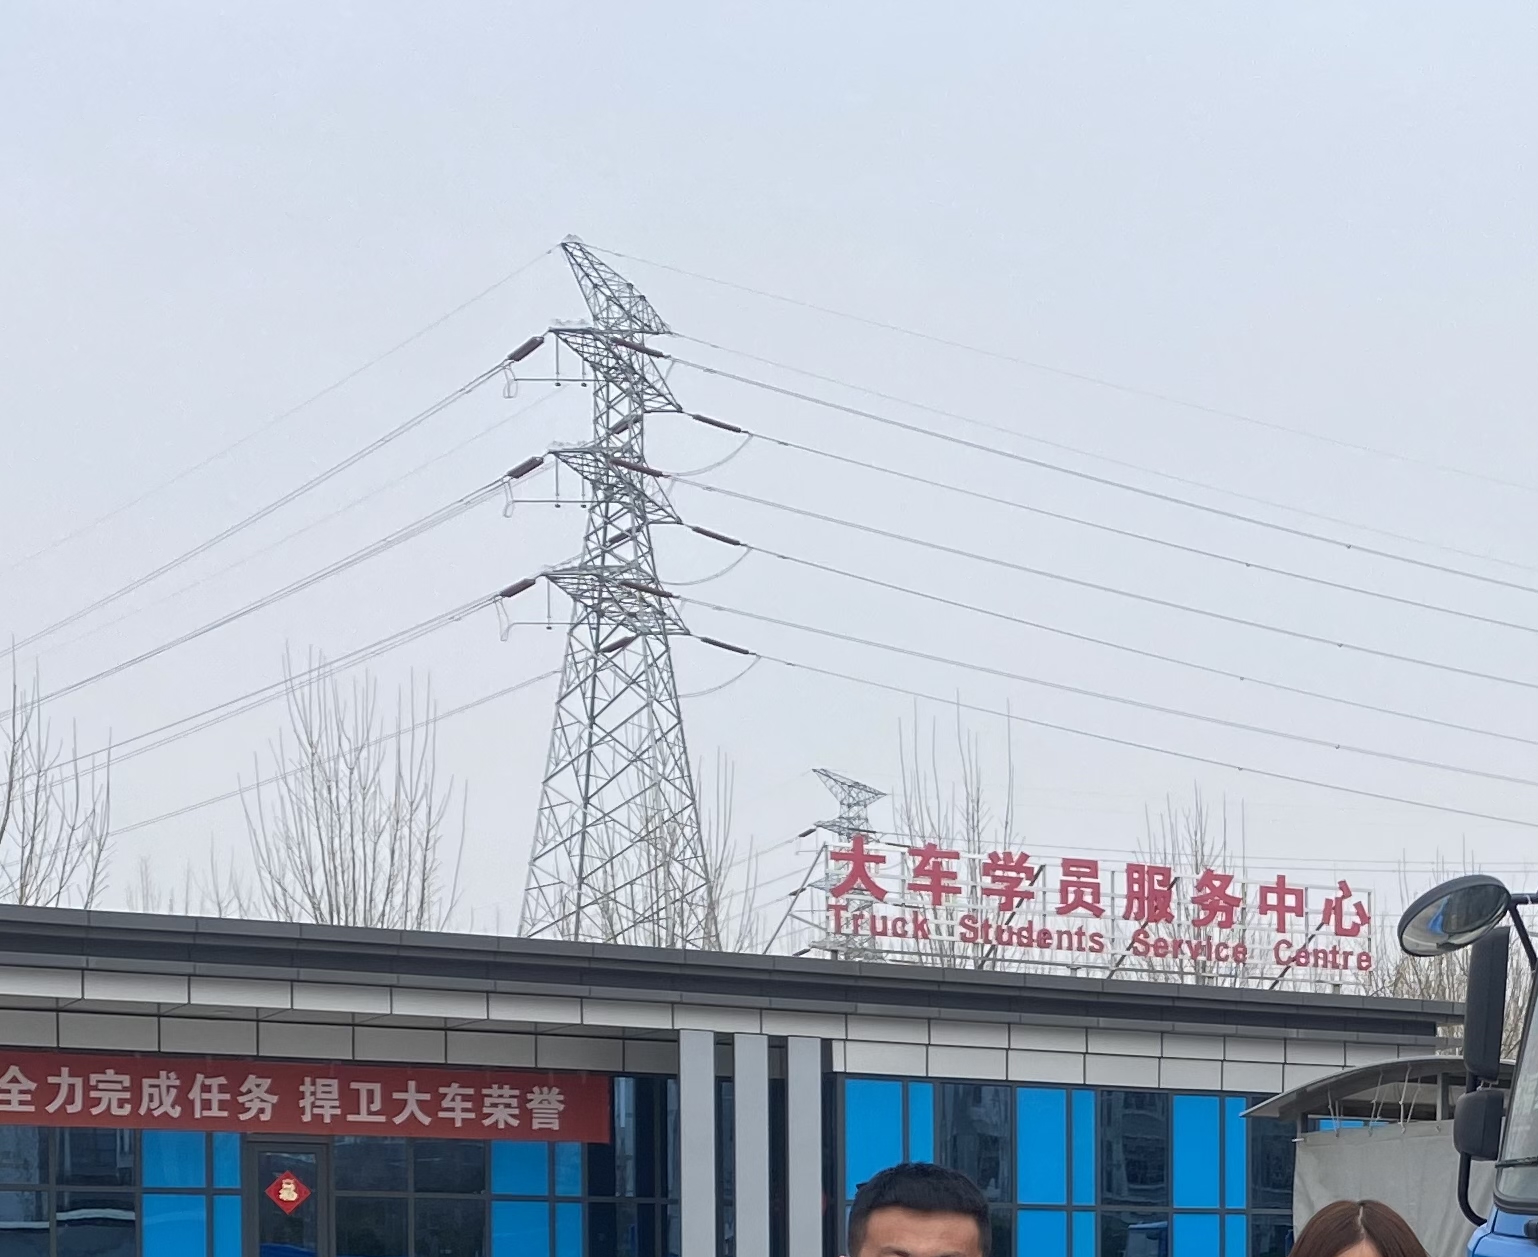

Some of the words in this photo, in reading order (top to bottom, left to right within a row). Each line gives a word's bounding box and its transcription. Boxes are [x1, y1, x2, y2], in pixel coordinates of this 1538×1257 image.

[829, 834, 1371, 937] 大车学员服务中心
[827, 904, 930, 939] Truck
[959, 914, 1105, 953] Students
[1132, 929, 1248, 963] Service
[1273, 939, 1372, 972] Centre
[0, 1065, 279, 1121] 全力完成任务
[299, 1076, 566, 1131] 捍卫大车荣誉
